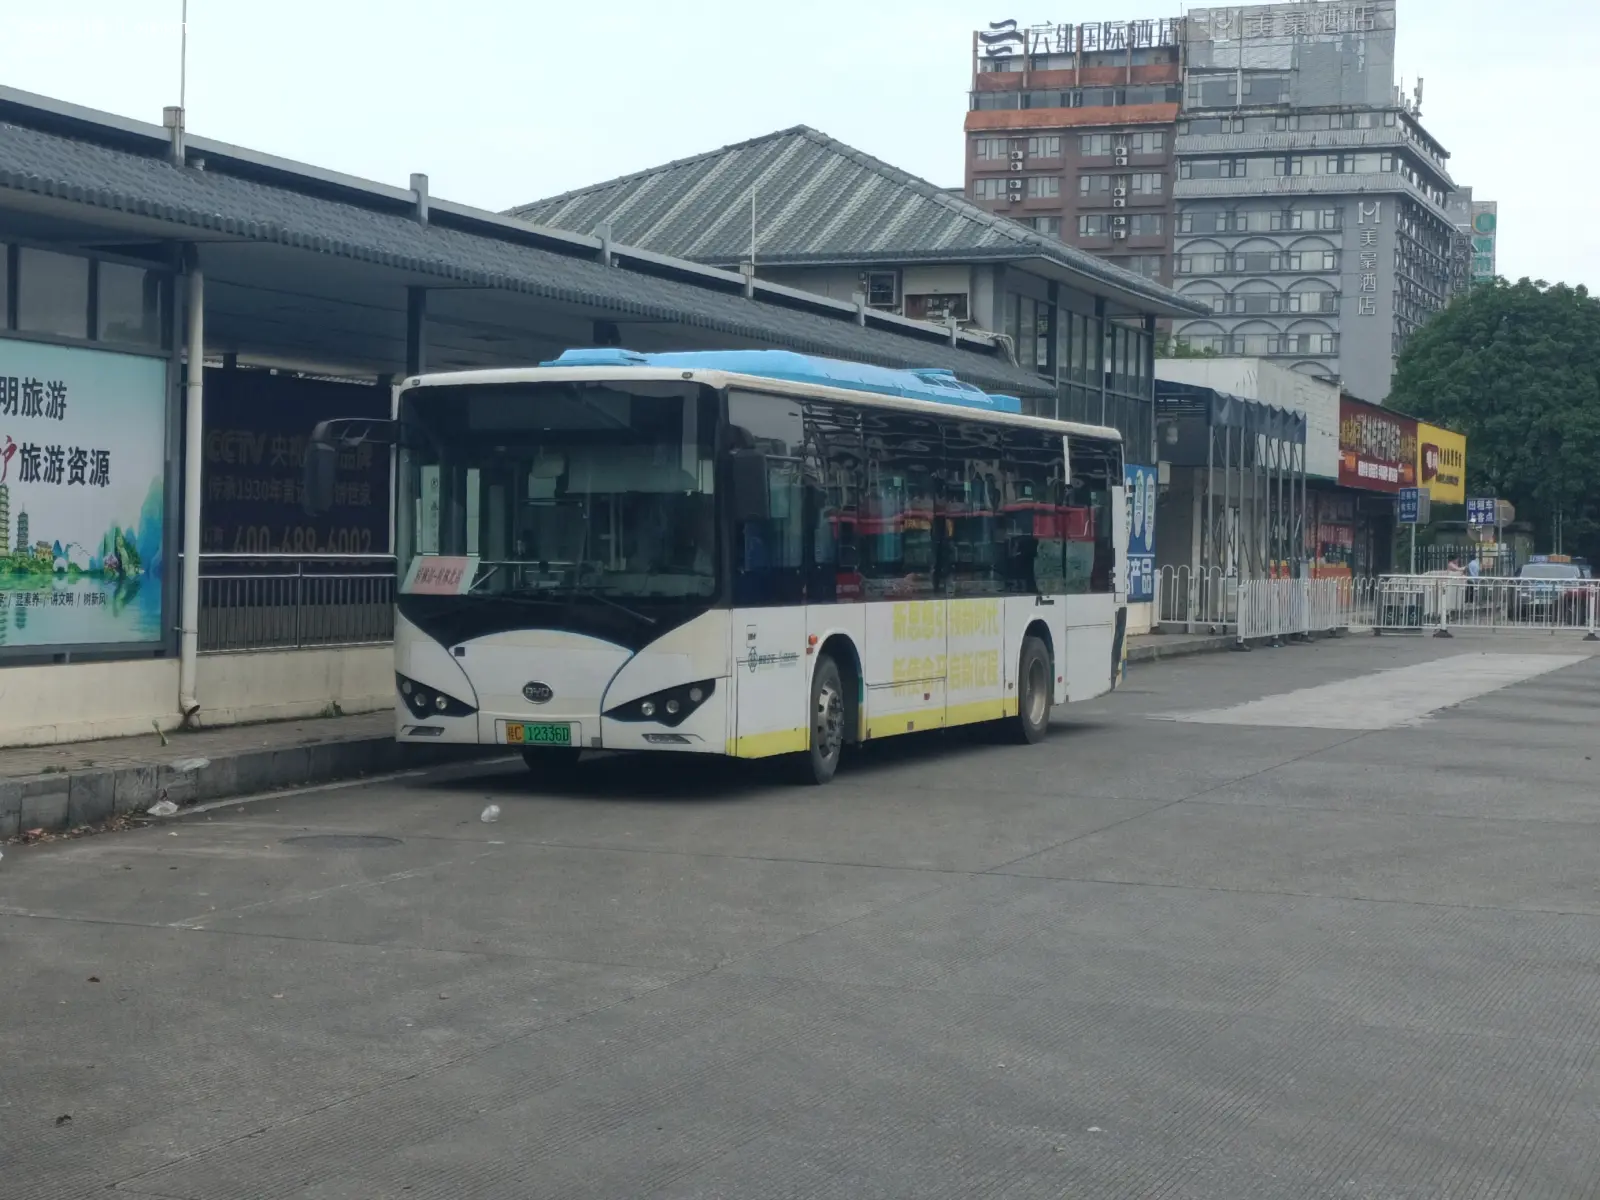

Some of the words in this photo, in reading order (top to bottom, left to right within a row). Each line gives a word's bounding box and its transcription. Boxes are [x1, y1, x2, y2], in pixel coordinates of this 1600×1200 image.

[0, 376, 67, 421] 明旅游
[1468, 500, 1493, 511] 出租车
